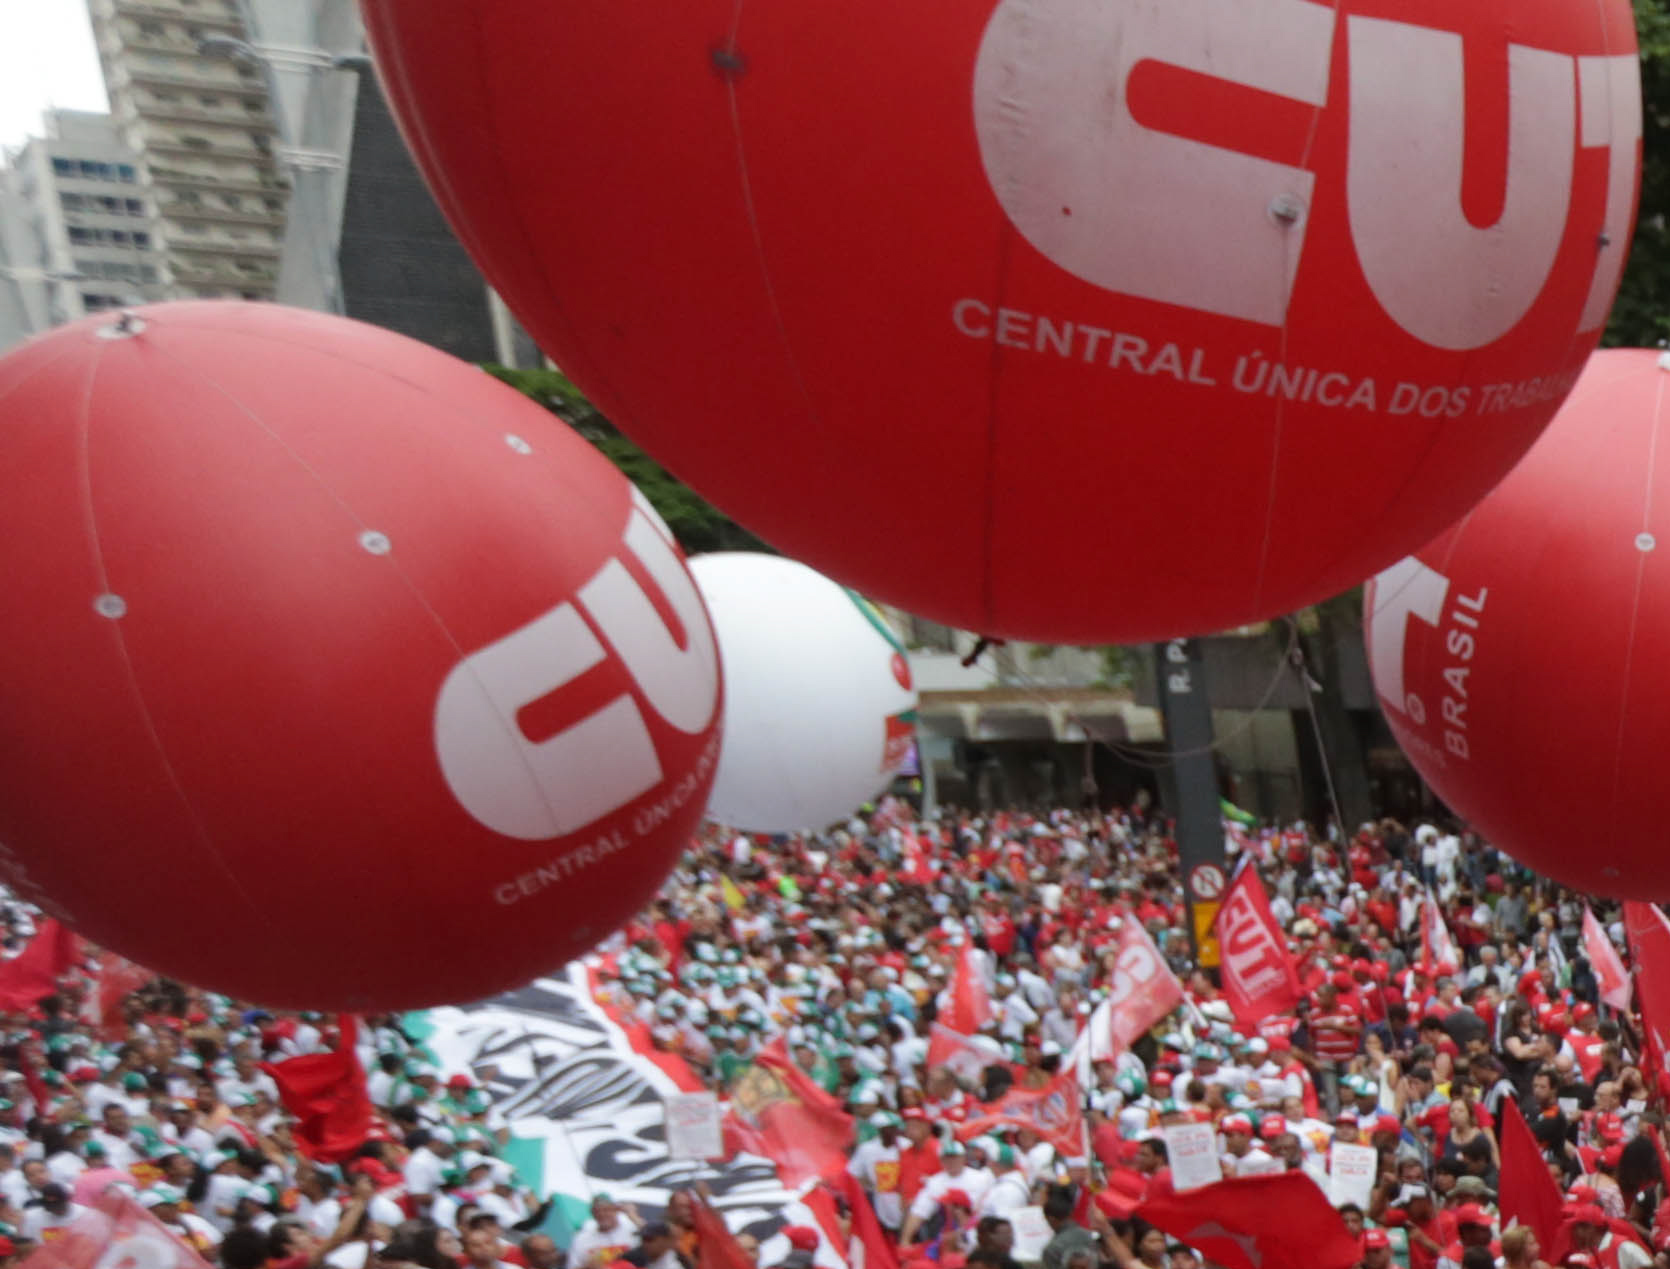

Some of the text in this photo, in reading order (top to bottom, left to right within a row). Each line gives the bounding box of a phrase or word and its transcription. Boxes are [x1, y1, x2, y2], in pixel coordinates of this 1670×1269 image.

[952, 298, 1467, 419] CENTRAL ÚNICA DOS
[1443, 587, 1489, 760] BRASIL
[494, 832, 629, 907] CENTRAL
